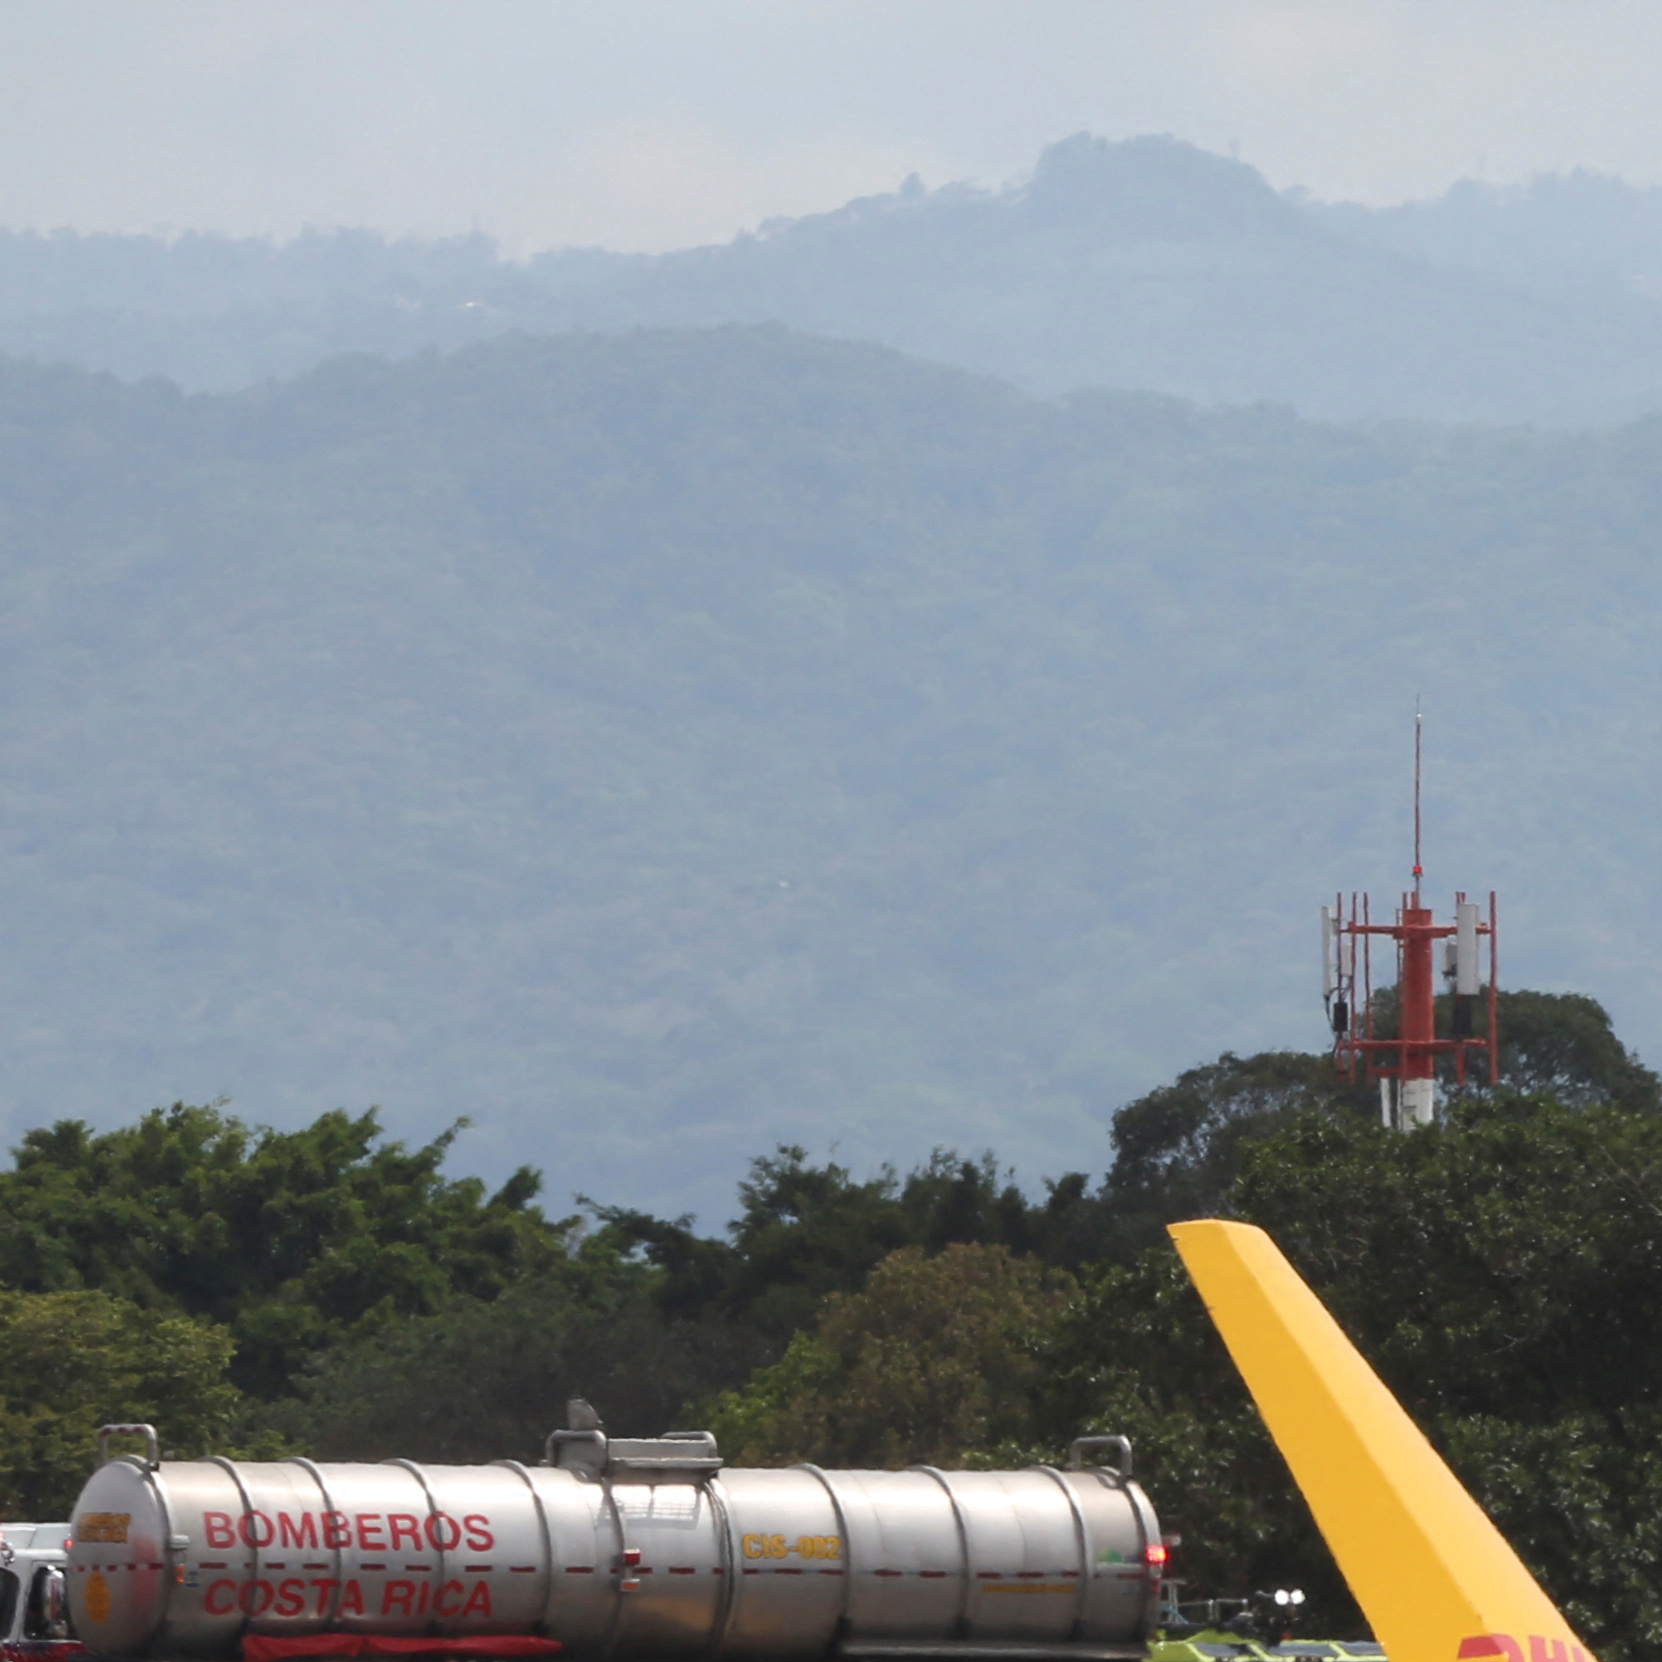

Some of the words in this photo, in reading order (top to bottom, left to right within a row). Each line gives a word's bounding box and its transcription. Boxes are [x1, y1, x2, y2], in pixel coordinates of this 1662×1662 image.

[203, 1510, 495, 1551] BOMBEROS
[203, 1578, 365, 1617] COSTA
[381, 1579, 493, 1618] RICA
